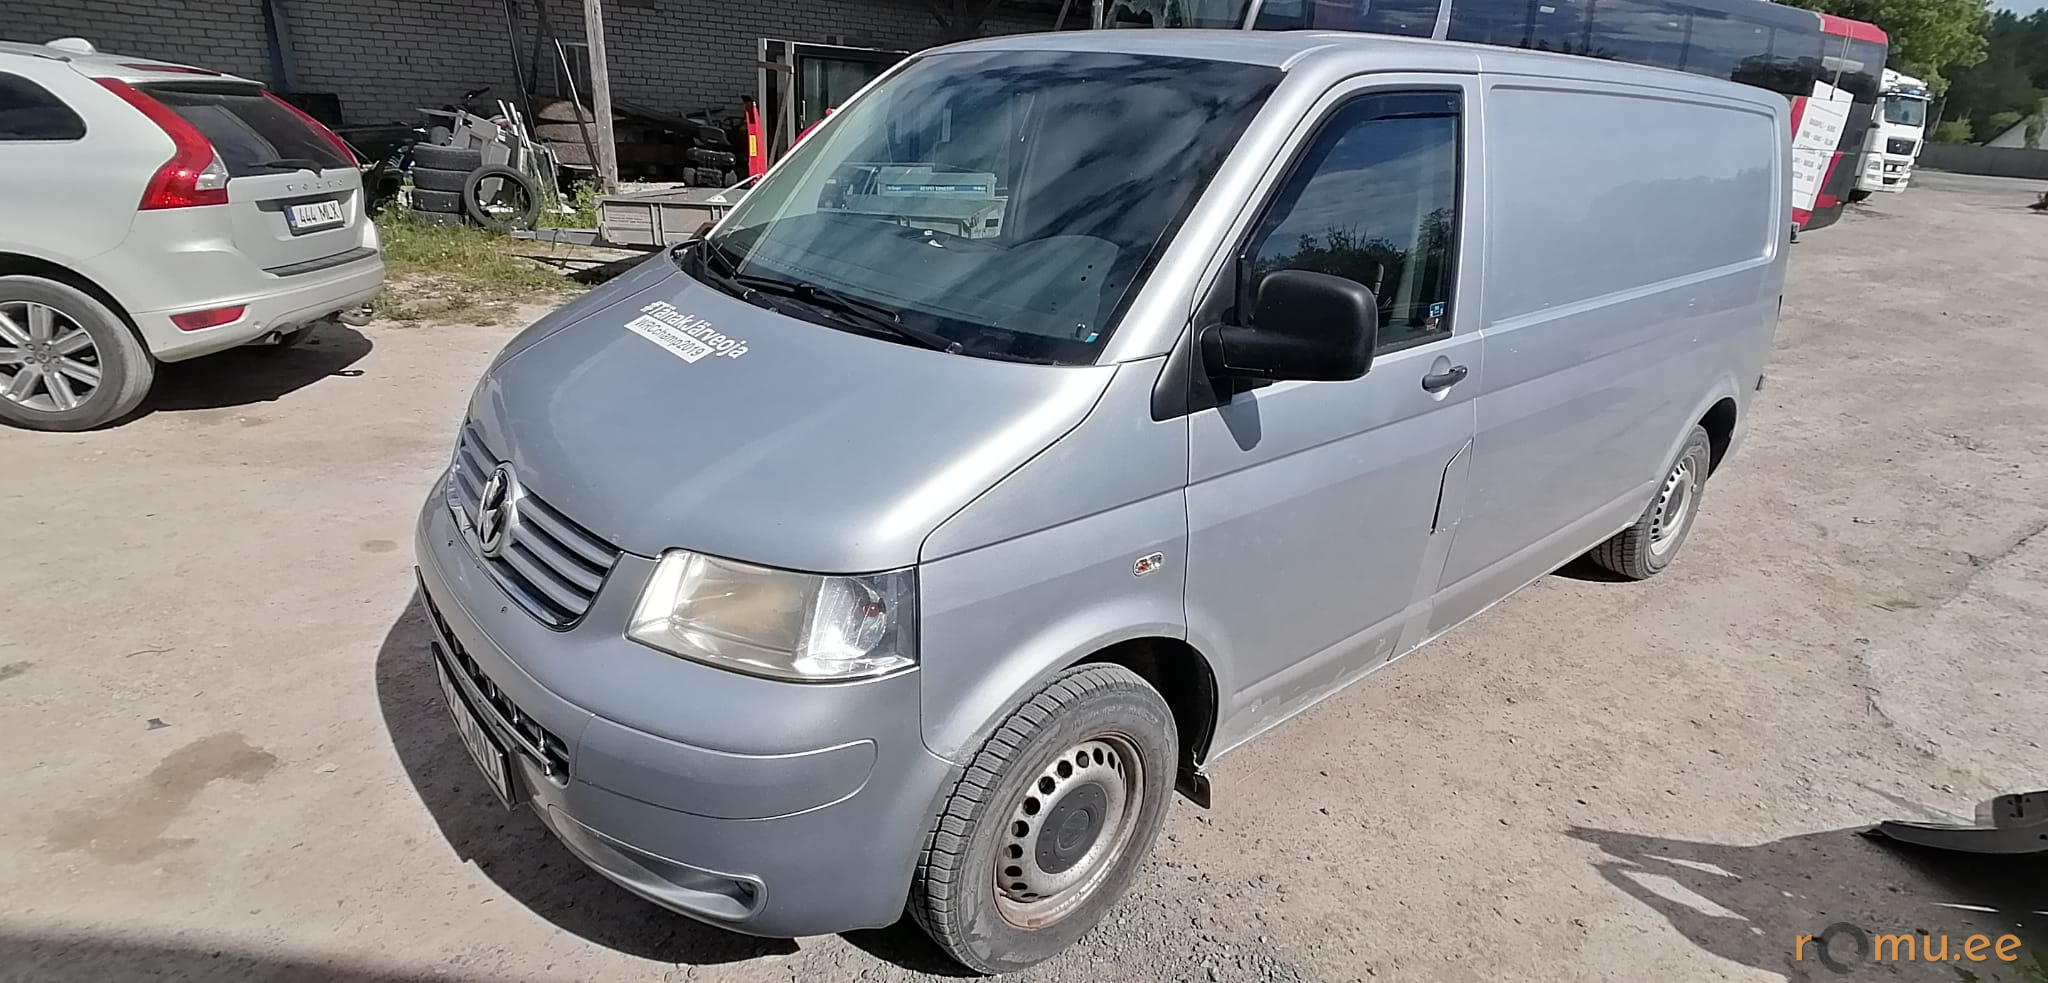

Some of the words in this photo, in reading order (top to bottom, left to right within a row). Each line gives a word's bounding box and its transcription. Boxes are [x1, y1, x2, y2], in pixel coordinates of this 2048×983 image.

[299, 206, 316, 223] 444
[634, 317, 705, 357] WRCchamp2019
[640, 300, 748, 359] #TänakJärveoja
